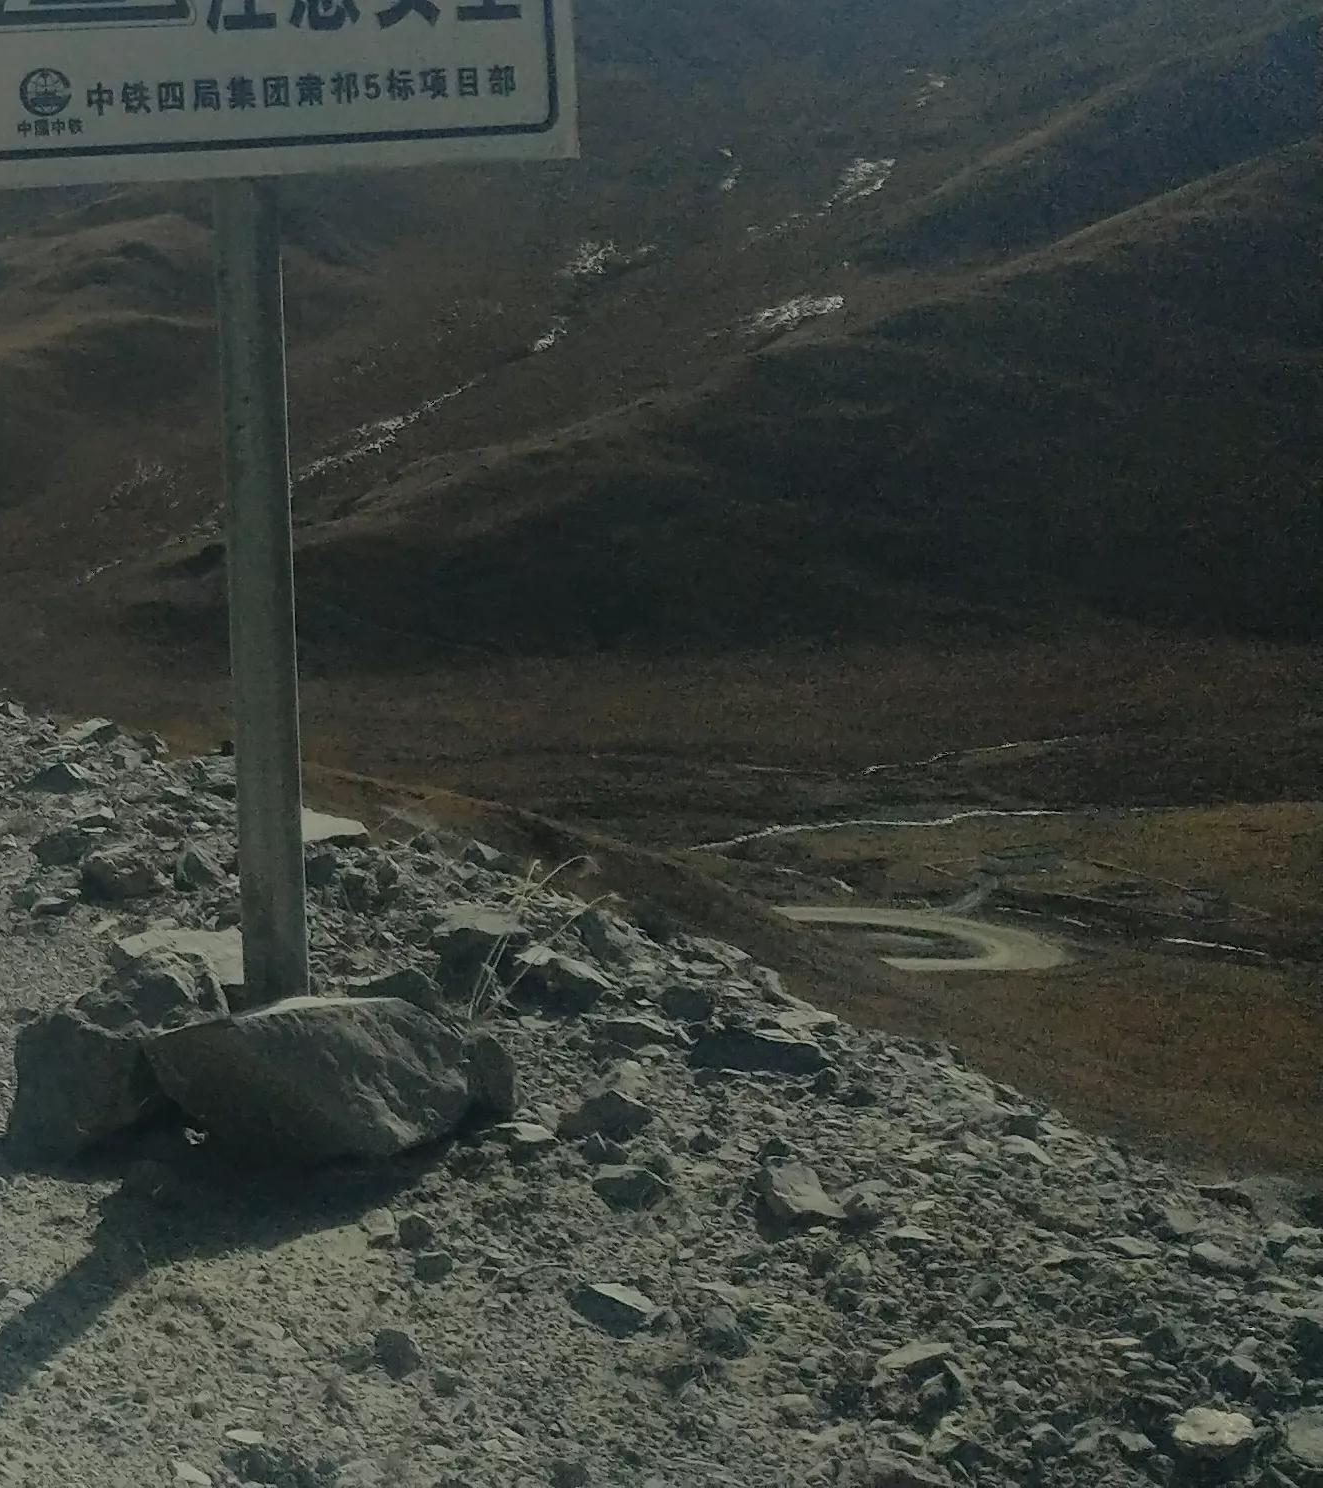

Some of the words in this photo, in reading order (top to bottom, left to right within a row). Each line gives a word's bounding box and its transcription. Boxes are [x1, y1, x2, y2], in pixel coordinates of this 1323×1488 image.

[86, 64, 517, 116] 中铁四局集团肃祁5标项目部
